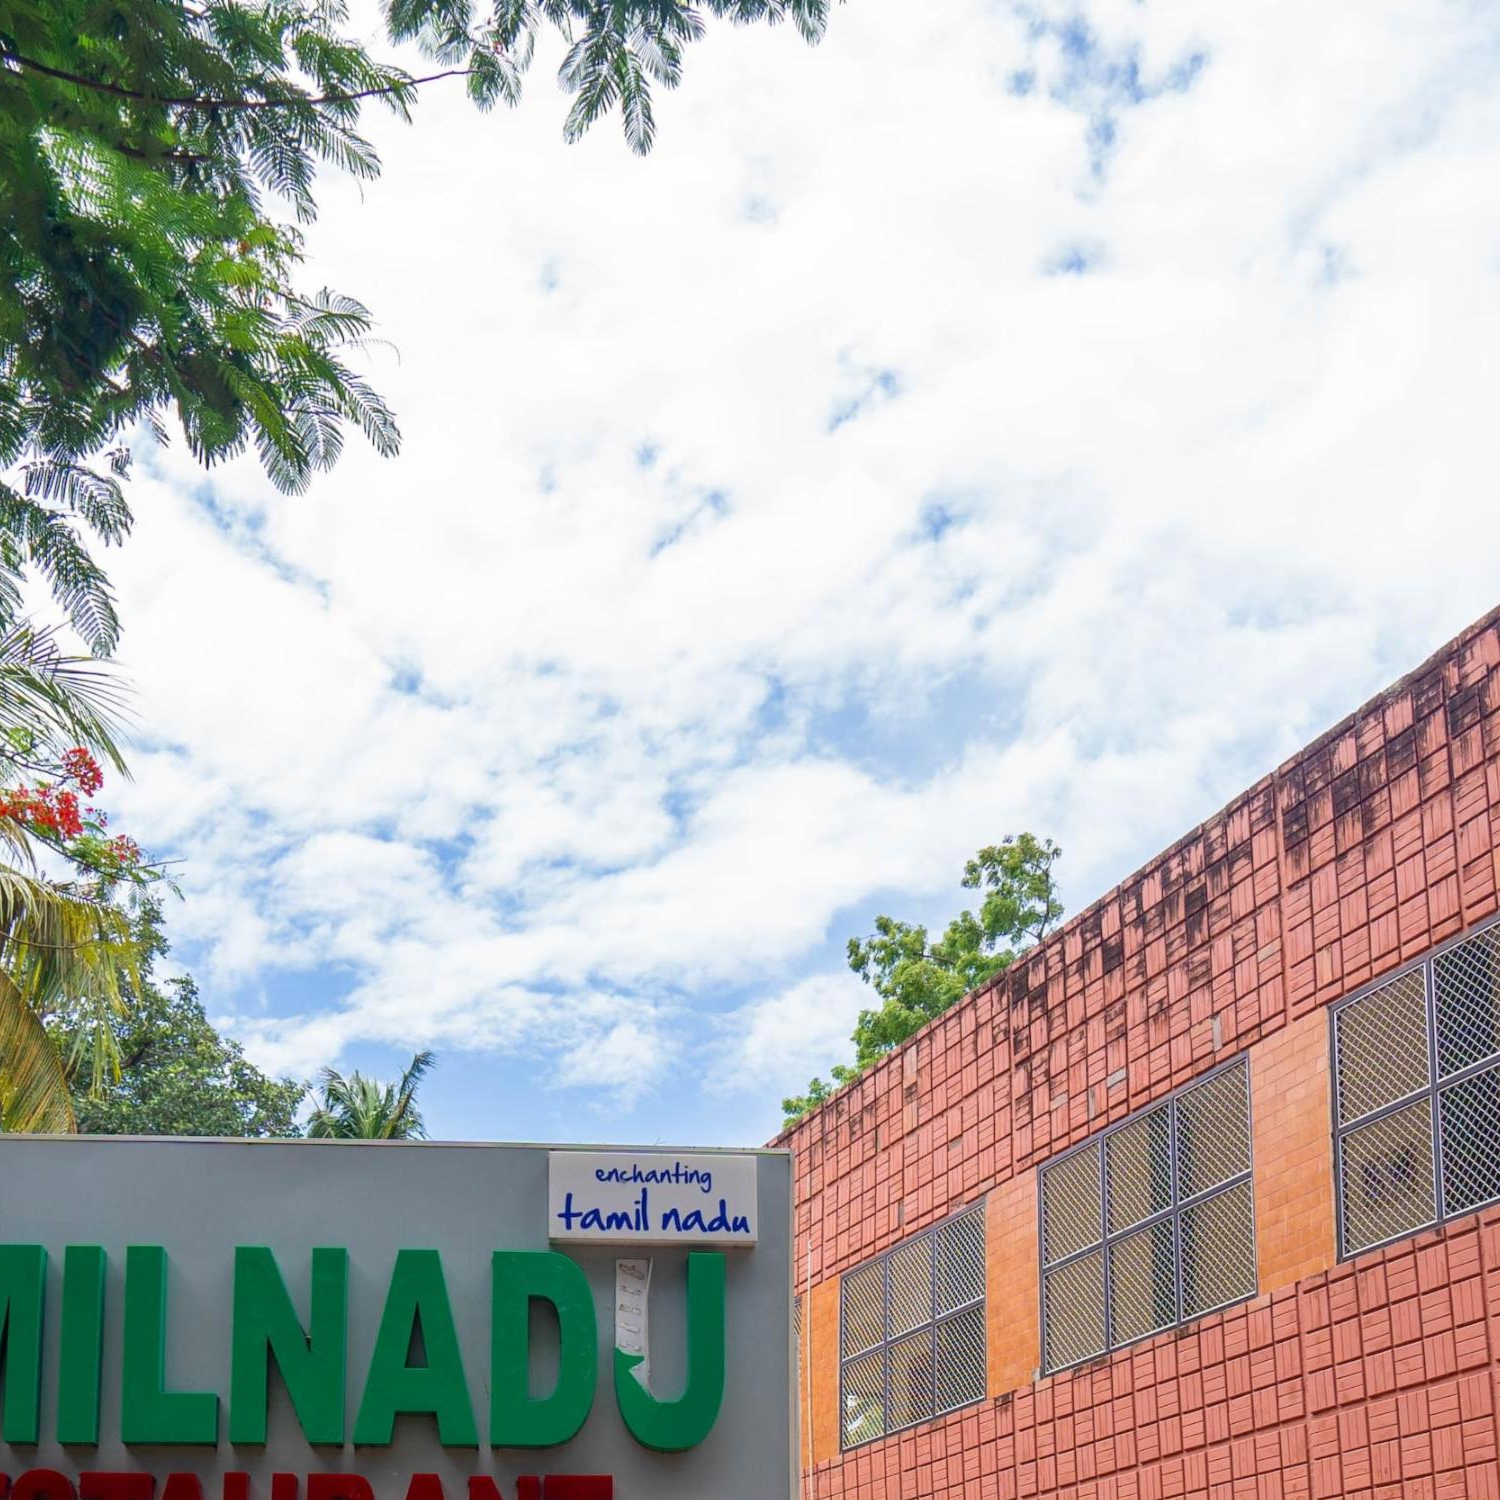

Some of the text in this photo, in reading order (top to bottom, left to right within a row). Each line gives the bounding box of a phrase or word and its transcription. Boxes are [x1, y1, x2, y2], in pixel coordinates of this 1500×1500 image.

[595, 1162, 712, 1193] enchanting
[557, 1187, 750, 1233] tamil nadu
